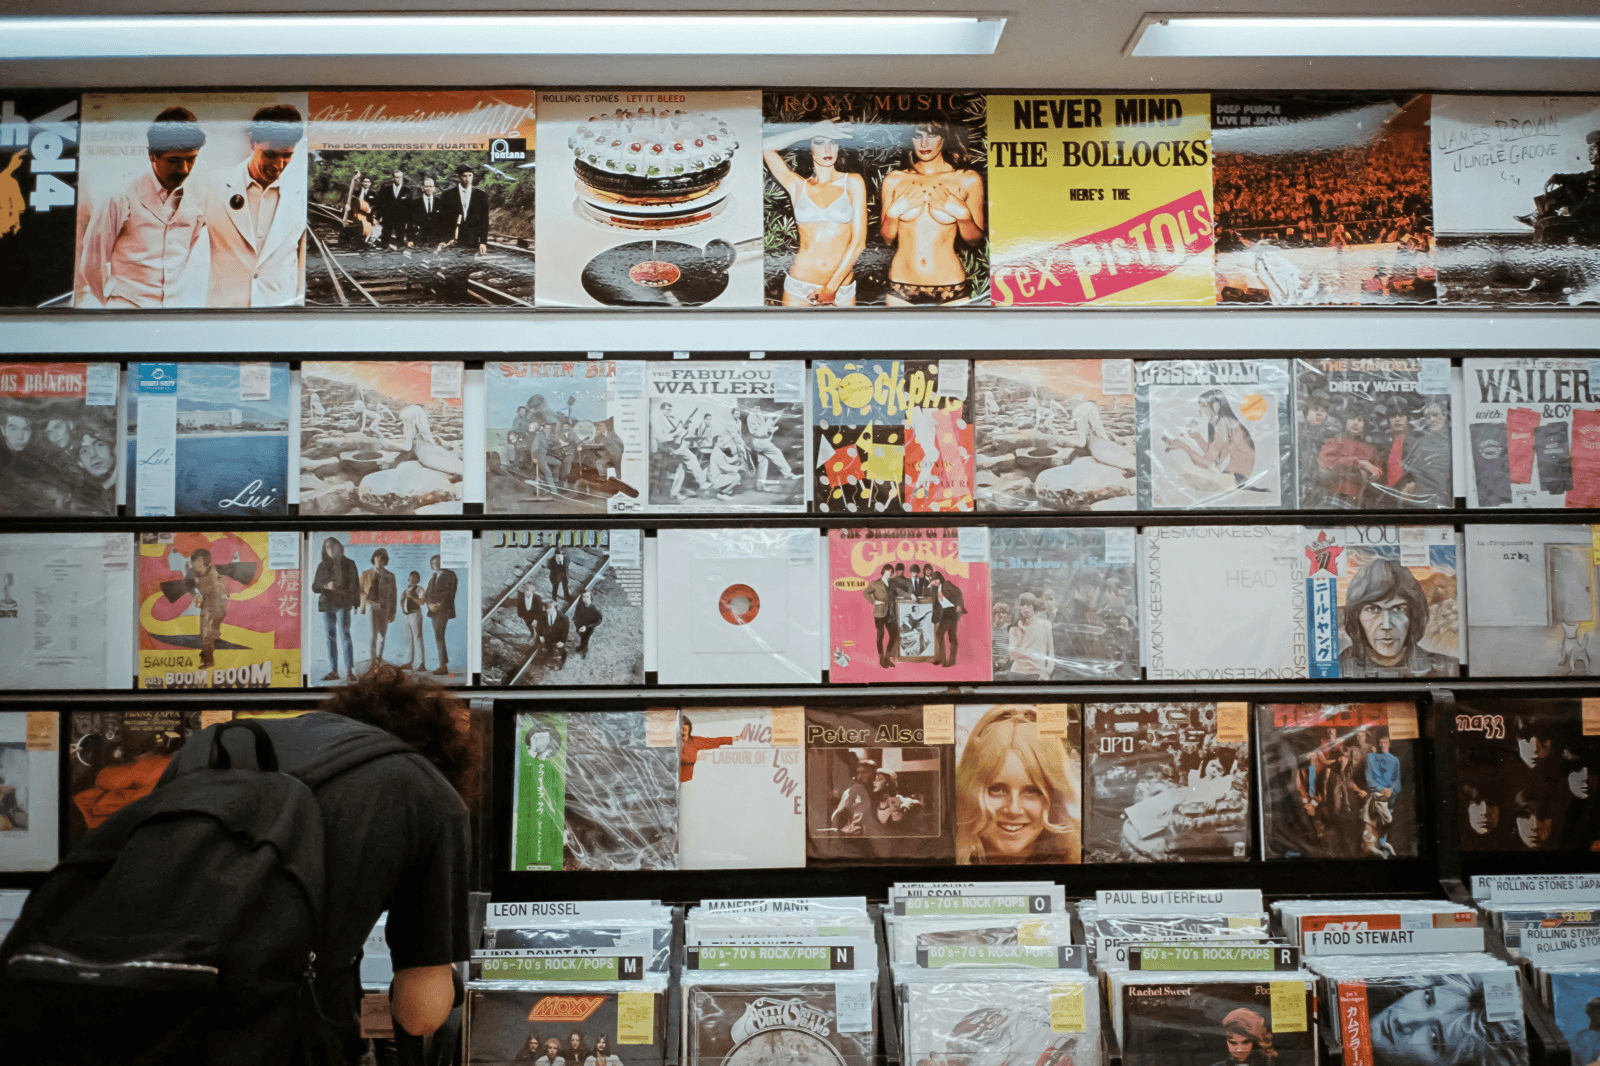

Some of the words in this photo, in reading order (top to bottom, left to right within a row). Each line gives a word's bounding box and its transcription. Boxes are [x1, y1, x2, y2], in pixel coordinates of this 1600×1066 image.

[542, 95, 581, 103] ROLLING
[584, 95, 619, 103] STONES
[626, 94, 643, 103] LET
[645, 94, 654, 103] IT
[657, 94, 686, 103] BLEED
[784, 95, 855, 111] ROXY
[874, 93, 961, 110] MUSIC
[1013, 99, 1102, 130] NEVER
[1115, 98, 1183, 128] MIND
[1216, 105, 1241, 115] DEEP
[1243, 105, 1281, 115] PURPLE
[1216, 116, 1239, 126] LIVE
[1240, 116, 1252, 126] IN
[321, 142, 342, 150] The
[371, 142, 433, 150] MORRISSEY
[436, 142, 485, 150] QUARTET
[491, 150, 526, 163] fontana
[990, 141, 1048, 168] THE
[1062, 139, 1209, 167] BOLLOCKS
[1509, 143, 1558, 164] GROOVE
[30, 174, 76, 212] 4
[1069, 188, 1105, 201] HERE'S
[1111, 188, 1131, 201] THE
[1350, 360, 1422, 372] STANDELL
[671, 370, 774, 380] FABULOU
[1216, 362, 1260, 384] DAV
[1328, 381, 1371, 393] DIRTY
[1372, 381, 1420, 393] WATER
[218, 479, 277, 508] Lui
[549, 530, 610, 547] THING
[1354, 525, 1400, 544] YOU
[1225, 569, 1278, 589] HEAD
[143, 656, 193, 668] SAKURA
[165, 670, 209, 686] BOOM
[213, 660, 273, 686] BOOM
[807, 725, 870, 744] Peter
[874, 724, 925, 743] Also
[712, 750, 753, 765] LABOUR
[754, 750, 767, 765] OF
[1496, 880, 1536, 892] ROLLING
[1538, 879, 1575, 891] STONES
[1105, 892, 1137, 904] PAUL
[1141, 891, 1223, 904] BUTTERFIELD
[493, 903, 527, 916] LEON
[531, 903, 580, 916] RUSSEL
[772, 899, 809, 912] MANN
[1324, 932, 1351, 945] ROD
[1355, 931, 1415, 944] STEWART
[1527, 929, 1567, 939] ROLLING
[759, 947, 826, 960] ROCK/POPS
[1536, 940, 1578, 954] ROLLING
[836, 948, 848, 963] N
[1064, 947, 1074, 961] P
[1115, 949, 1126, 962] Q
[1202, 948, 1271, 960] ROCK/POPS
[1281, 949, 1292, 964] R
[544, 957, 615, 970] ROCK/POPS
[624, 958, 637, 974] M
[1128, 986, 1163, 997] Rachel
[1164, 986, 1193, 997] Sweet
[535, 995, 606, 1017] MOXY
